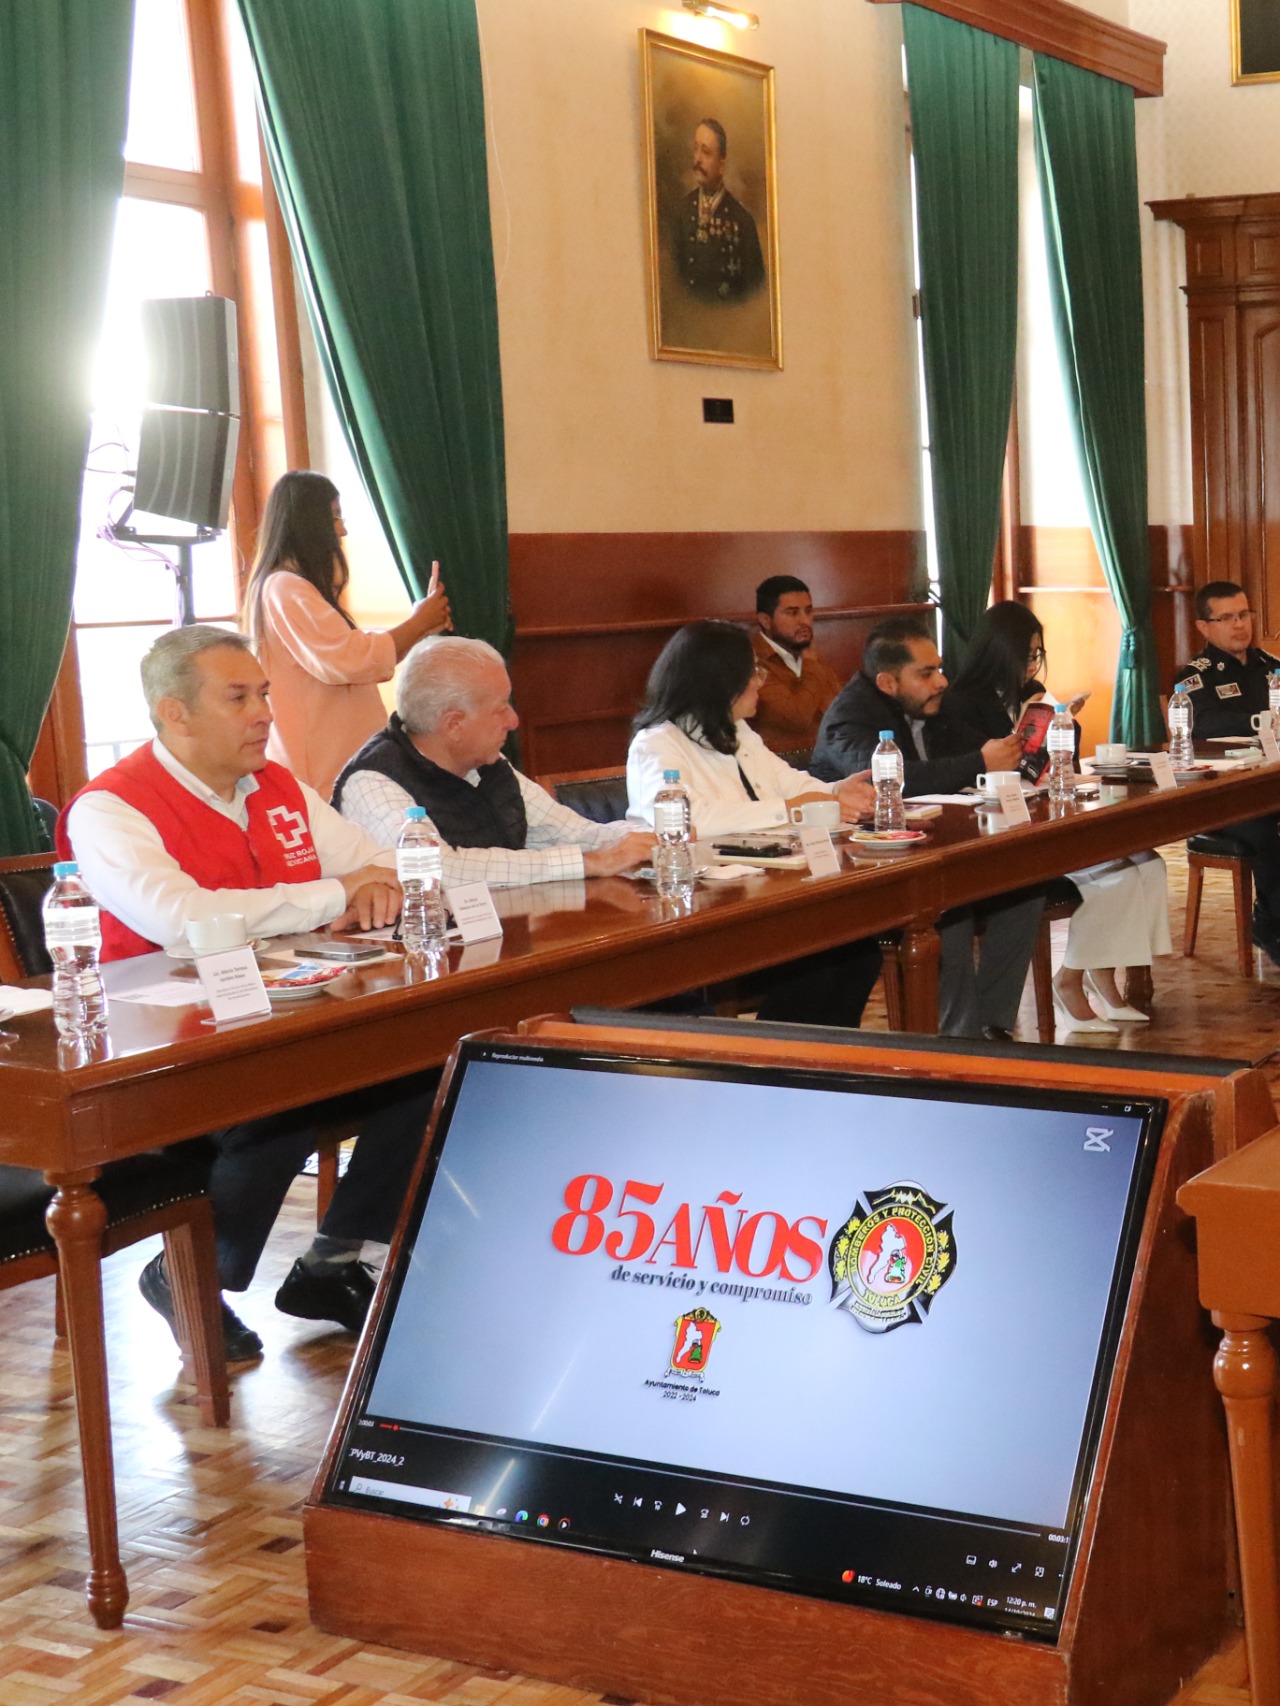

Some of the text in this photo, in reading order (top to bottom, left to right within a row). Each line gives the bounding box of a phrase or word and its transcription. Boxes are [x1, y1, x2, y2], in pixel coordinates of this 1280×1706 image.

[551, 1174, 829, 1283] 85 AÑOS
[850, 1214, 881, 1273] BOMBEROS
[882, 1209, 889, 1218] Y
[916, 1257, 933, 1285] CIVIL
[611, 1265, 813, 1305] de servicio y compromiso
[644, 1379, 720, 1397] Ayuntamiento de Toluca
[663, 1391, 678, 1399] 2022
[681, 1393, 697, 1402] 2024
[650, 1549, 685, 1563] Hisense
[857, 1574, 902, 1590] 18°C Soleado
[986, 1598, 999, 1607] ESP
[1006, 1596, 1021, 1607] 12:20
